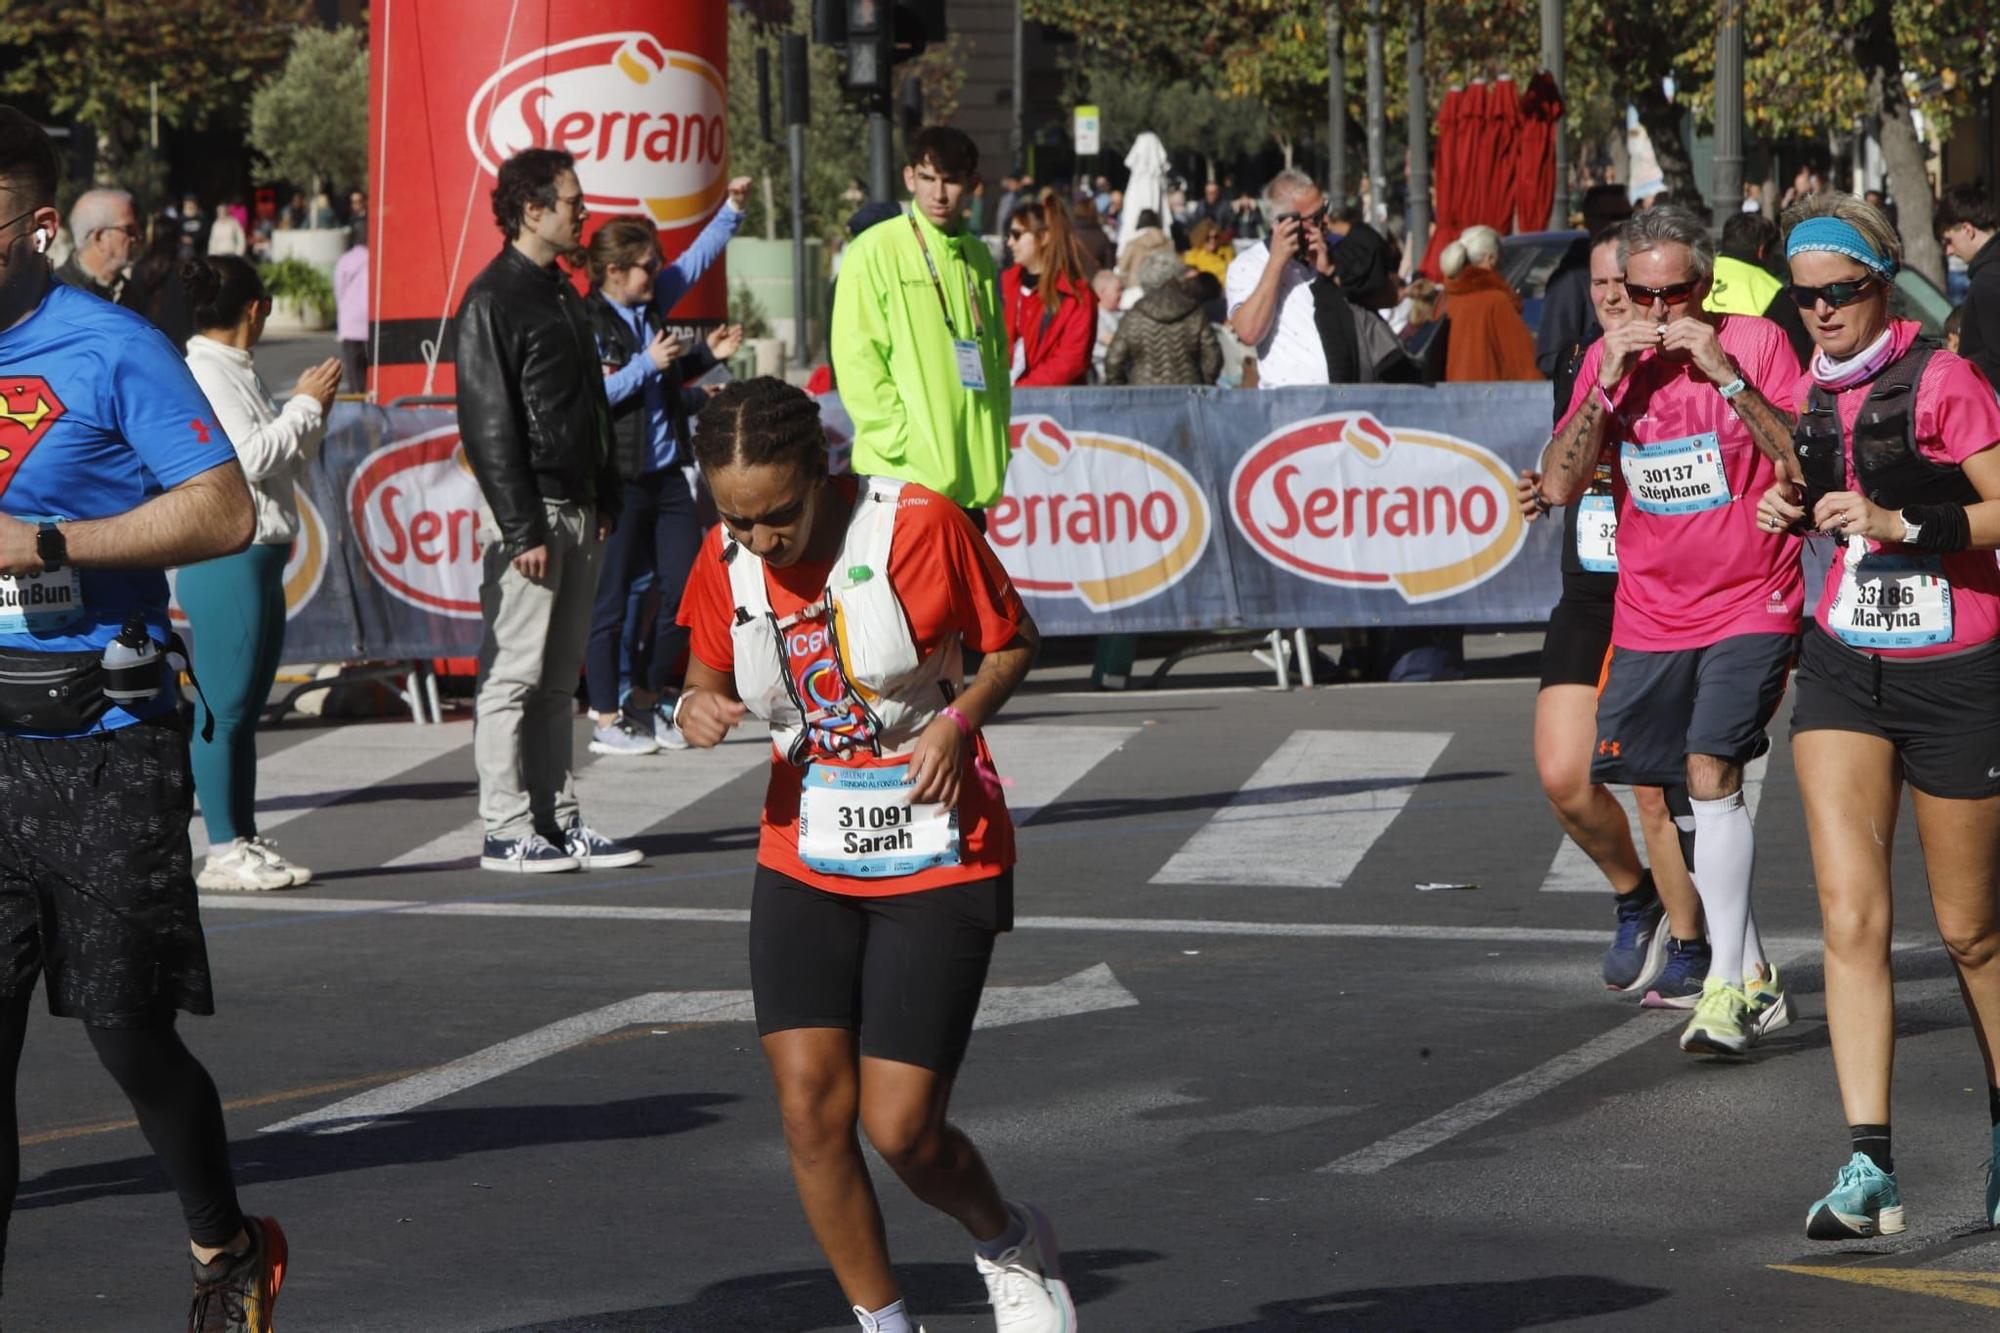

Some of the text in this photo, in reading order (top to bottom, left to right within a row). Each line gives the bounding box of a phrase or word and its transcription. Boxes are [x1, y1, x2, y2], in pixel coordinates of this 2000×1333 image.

[507, 87, 725, 166] Serrano
[1642, 464, 1694, 483] 30137
[1266, 464, 1498, 538] Serrano
[1638, 481, 1712, 503] Stéphane
[985, 491, 1177, 546] errano
[1599, 523, 1617, 539] 32
[1857, 585, 1915, 605] 33186
[1851, 607, 1921, 631] Maryna
[838, 805, 913, 829] 31091
[843, 828, 914, 854] Sarah
